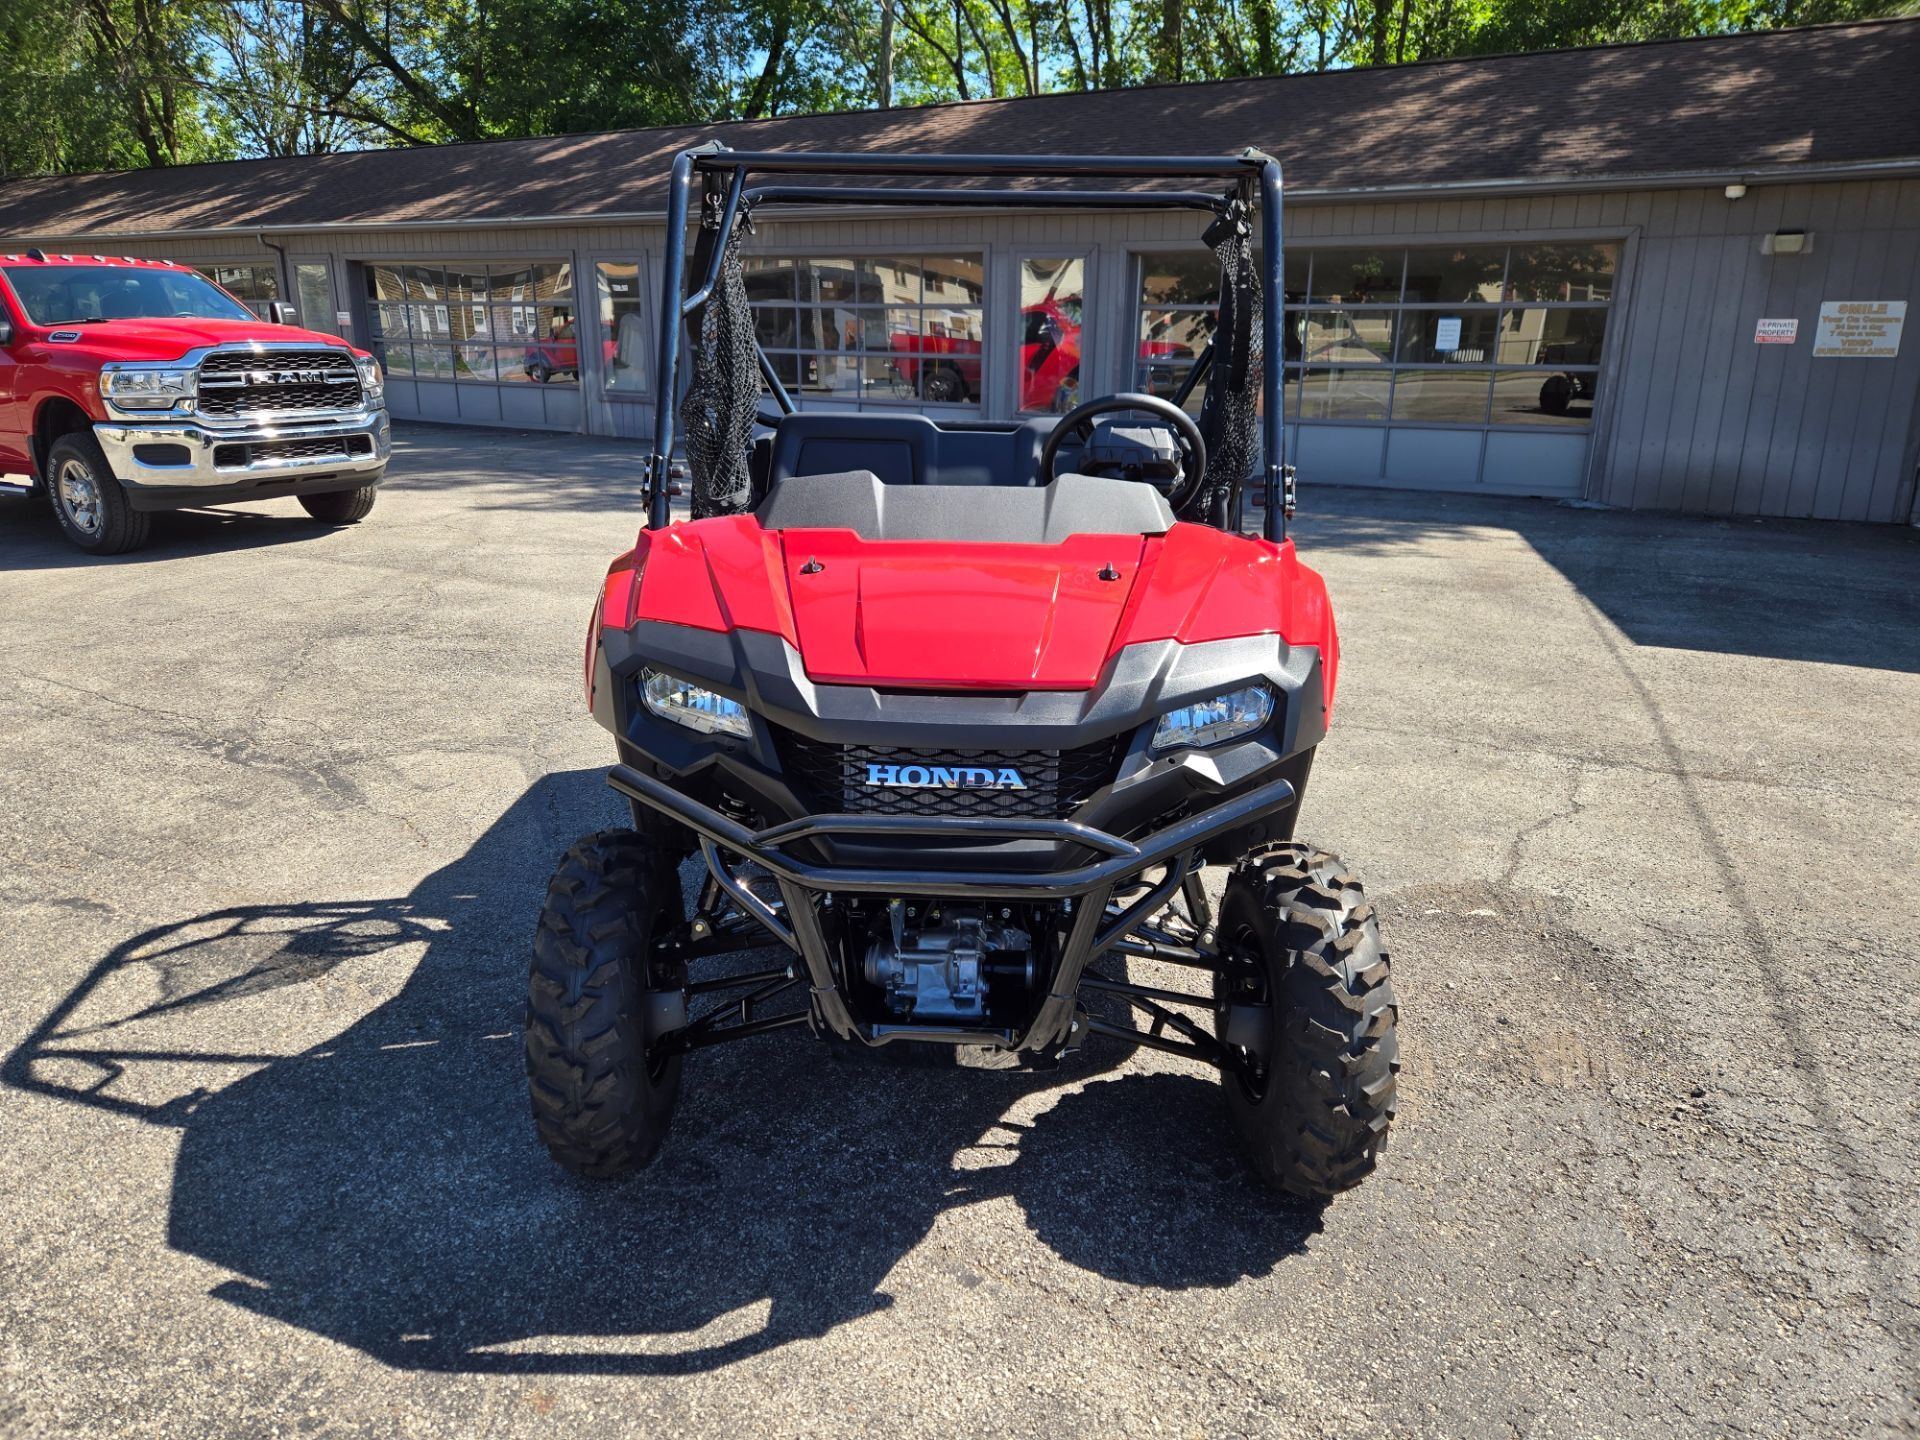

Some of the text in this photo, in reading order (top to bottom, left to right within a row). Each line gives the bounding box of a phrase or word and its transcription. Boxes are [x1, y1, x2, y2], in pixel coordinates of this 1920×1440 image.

[1838, 303, 1888, 314] SMILE
[252, 369, 322, 384] RAM
[865, 764, 1028, 790] HONDA
